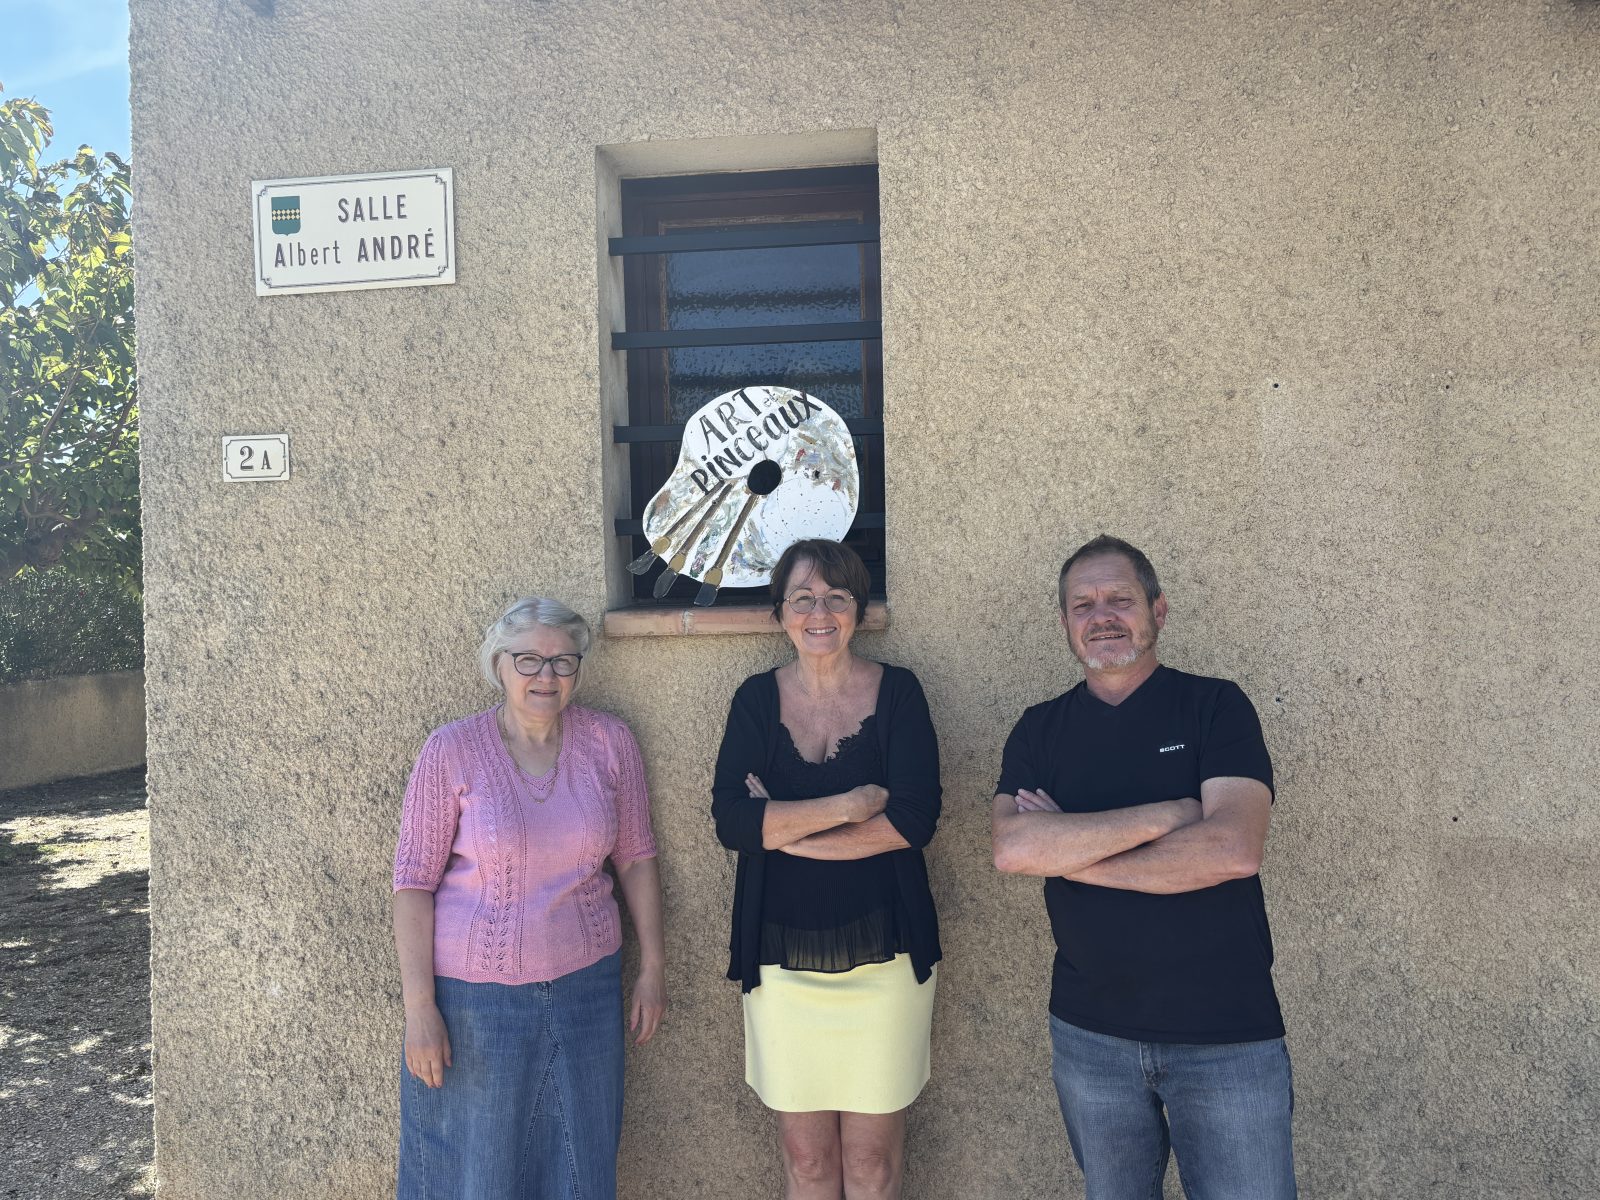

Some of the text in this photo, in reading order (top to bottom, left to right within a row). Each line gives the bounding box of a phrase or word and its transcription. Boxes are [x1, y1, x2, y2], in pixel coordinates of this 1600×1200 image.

[338, 194, 408, 223] SALLE
[274, 228, 435, 268] Albert ANDRÉ
[699, 388, 762, 455] ART
